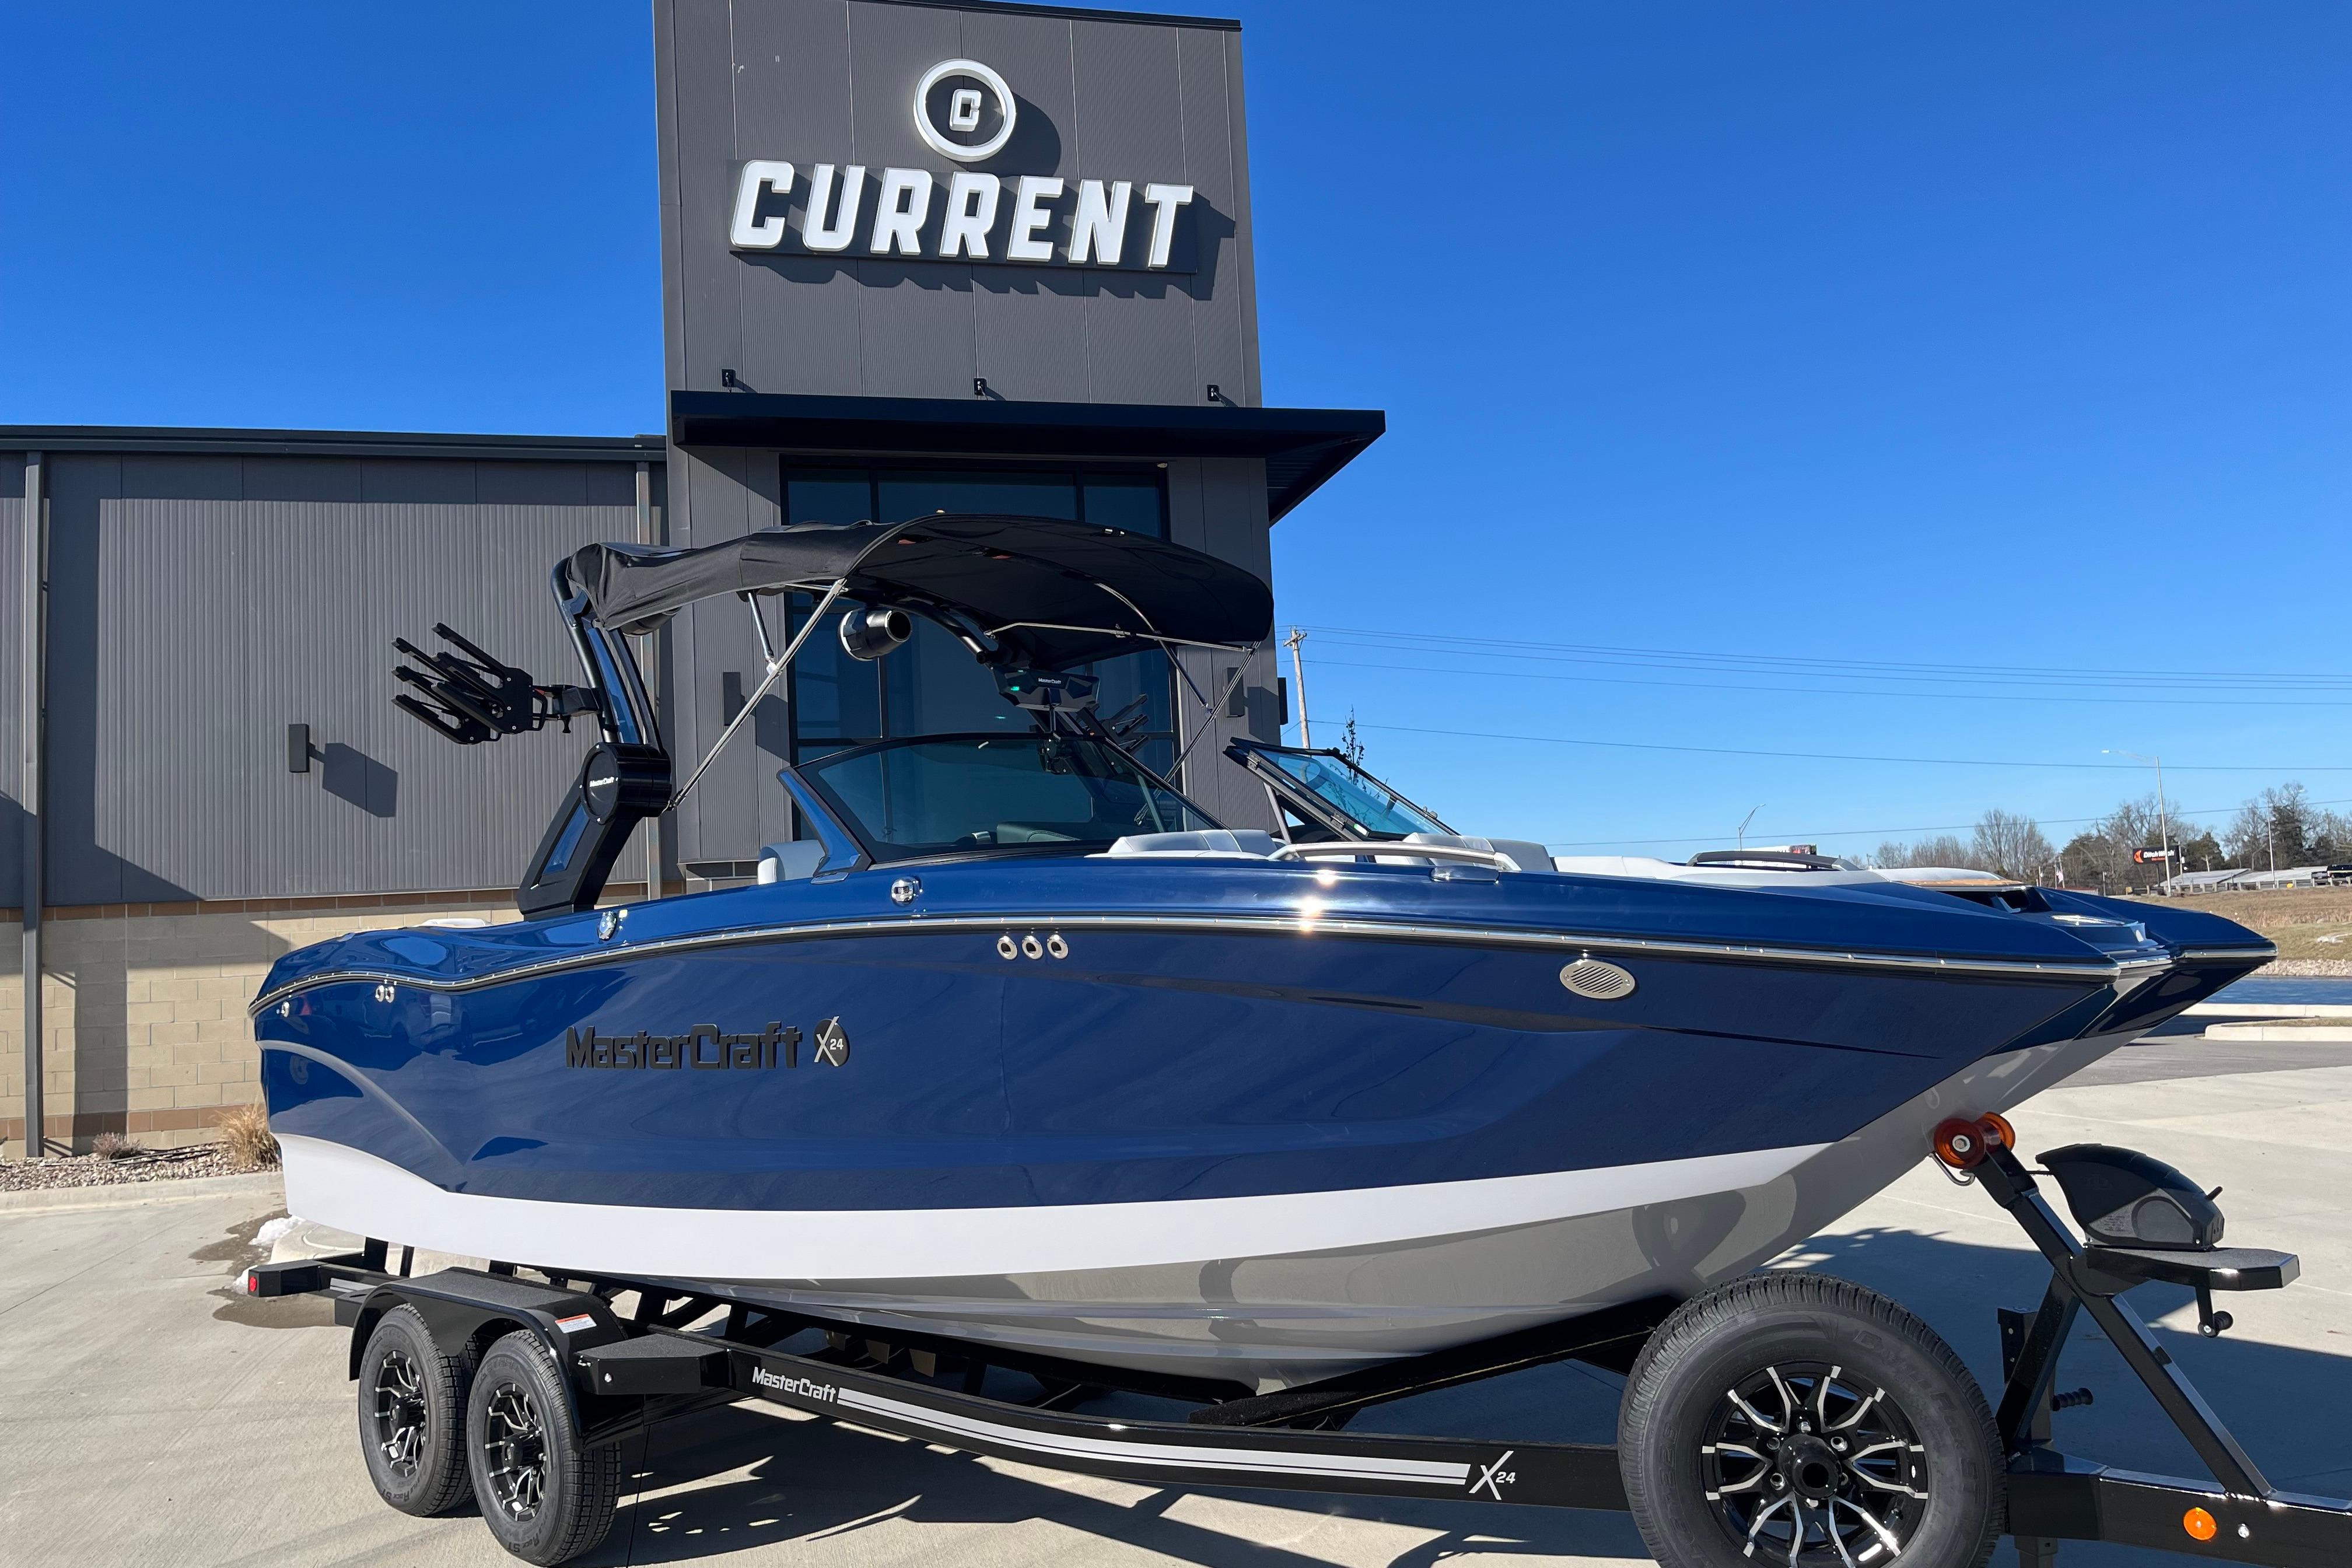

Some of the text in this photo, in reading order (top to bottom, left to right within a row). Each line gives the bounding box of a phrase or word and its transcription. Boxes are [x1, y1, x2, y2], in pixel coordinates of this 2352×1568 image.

[950, 89, 982, 132] C
[730, 160, 1194, 270] CURRENT
[565, 1020, 803, 1069] MasterCraft
[752, 1366, 836, 1403] MasterCraft
